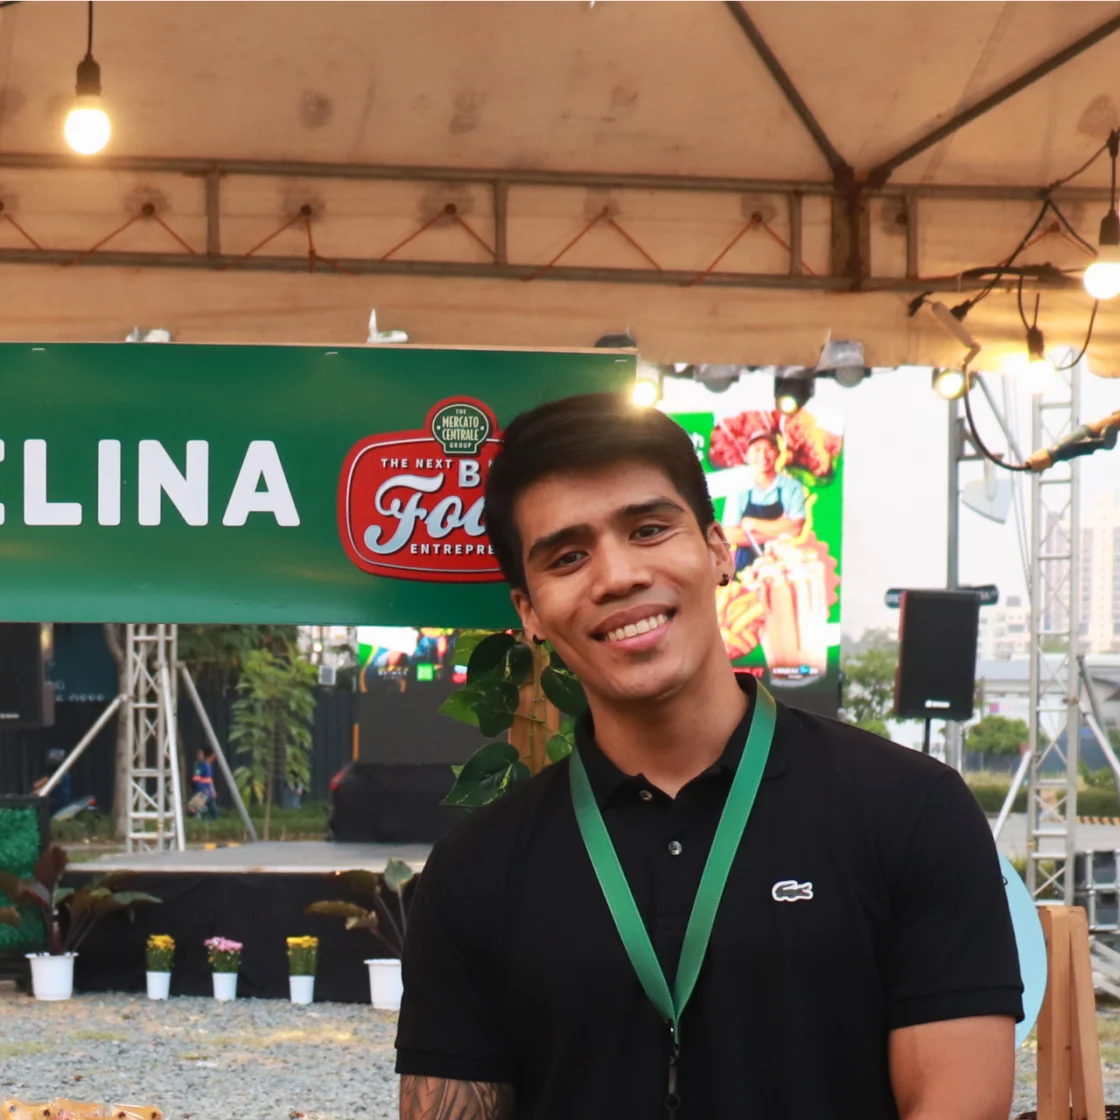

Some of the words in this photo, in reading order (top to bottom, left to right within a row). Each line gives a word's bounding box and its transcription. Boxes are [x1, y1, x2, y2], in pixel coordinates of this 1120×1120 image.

[442, 415, 479, 428] MERCATO
[441, 428, 479, 441] CENTRALE
[381, 458, 409, 469] THE
[415, 459, 453, 469] NEXT
